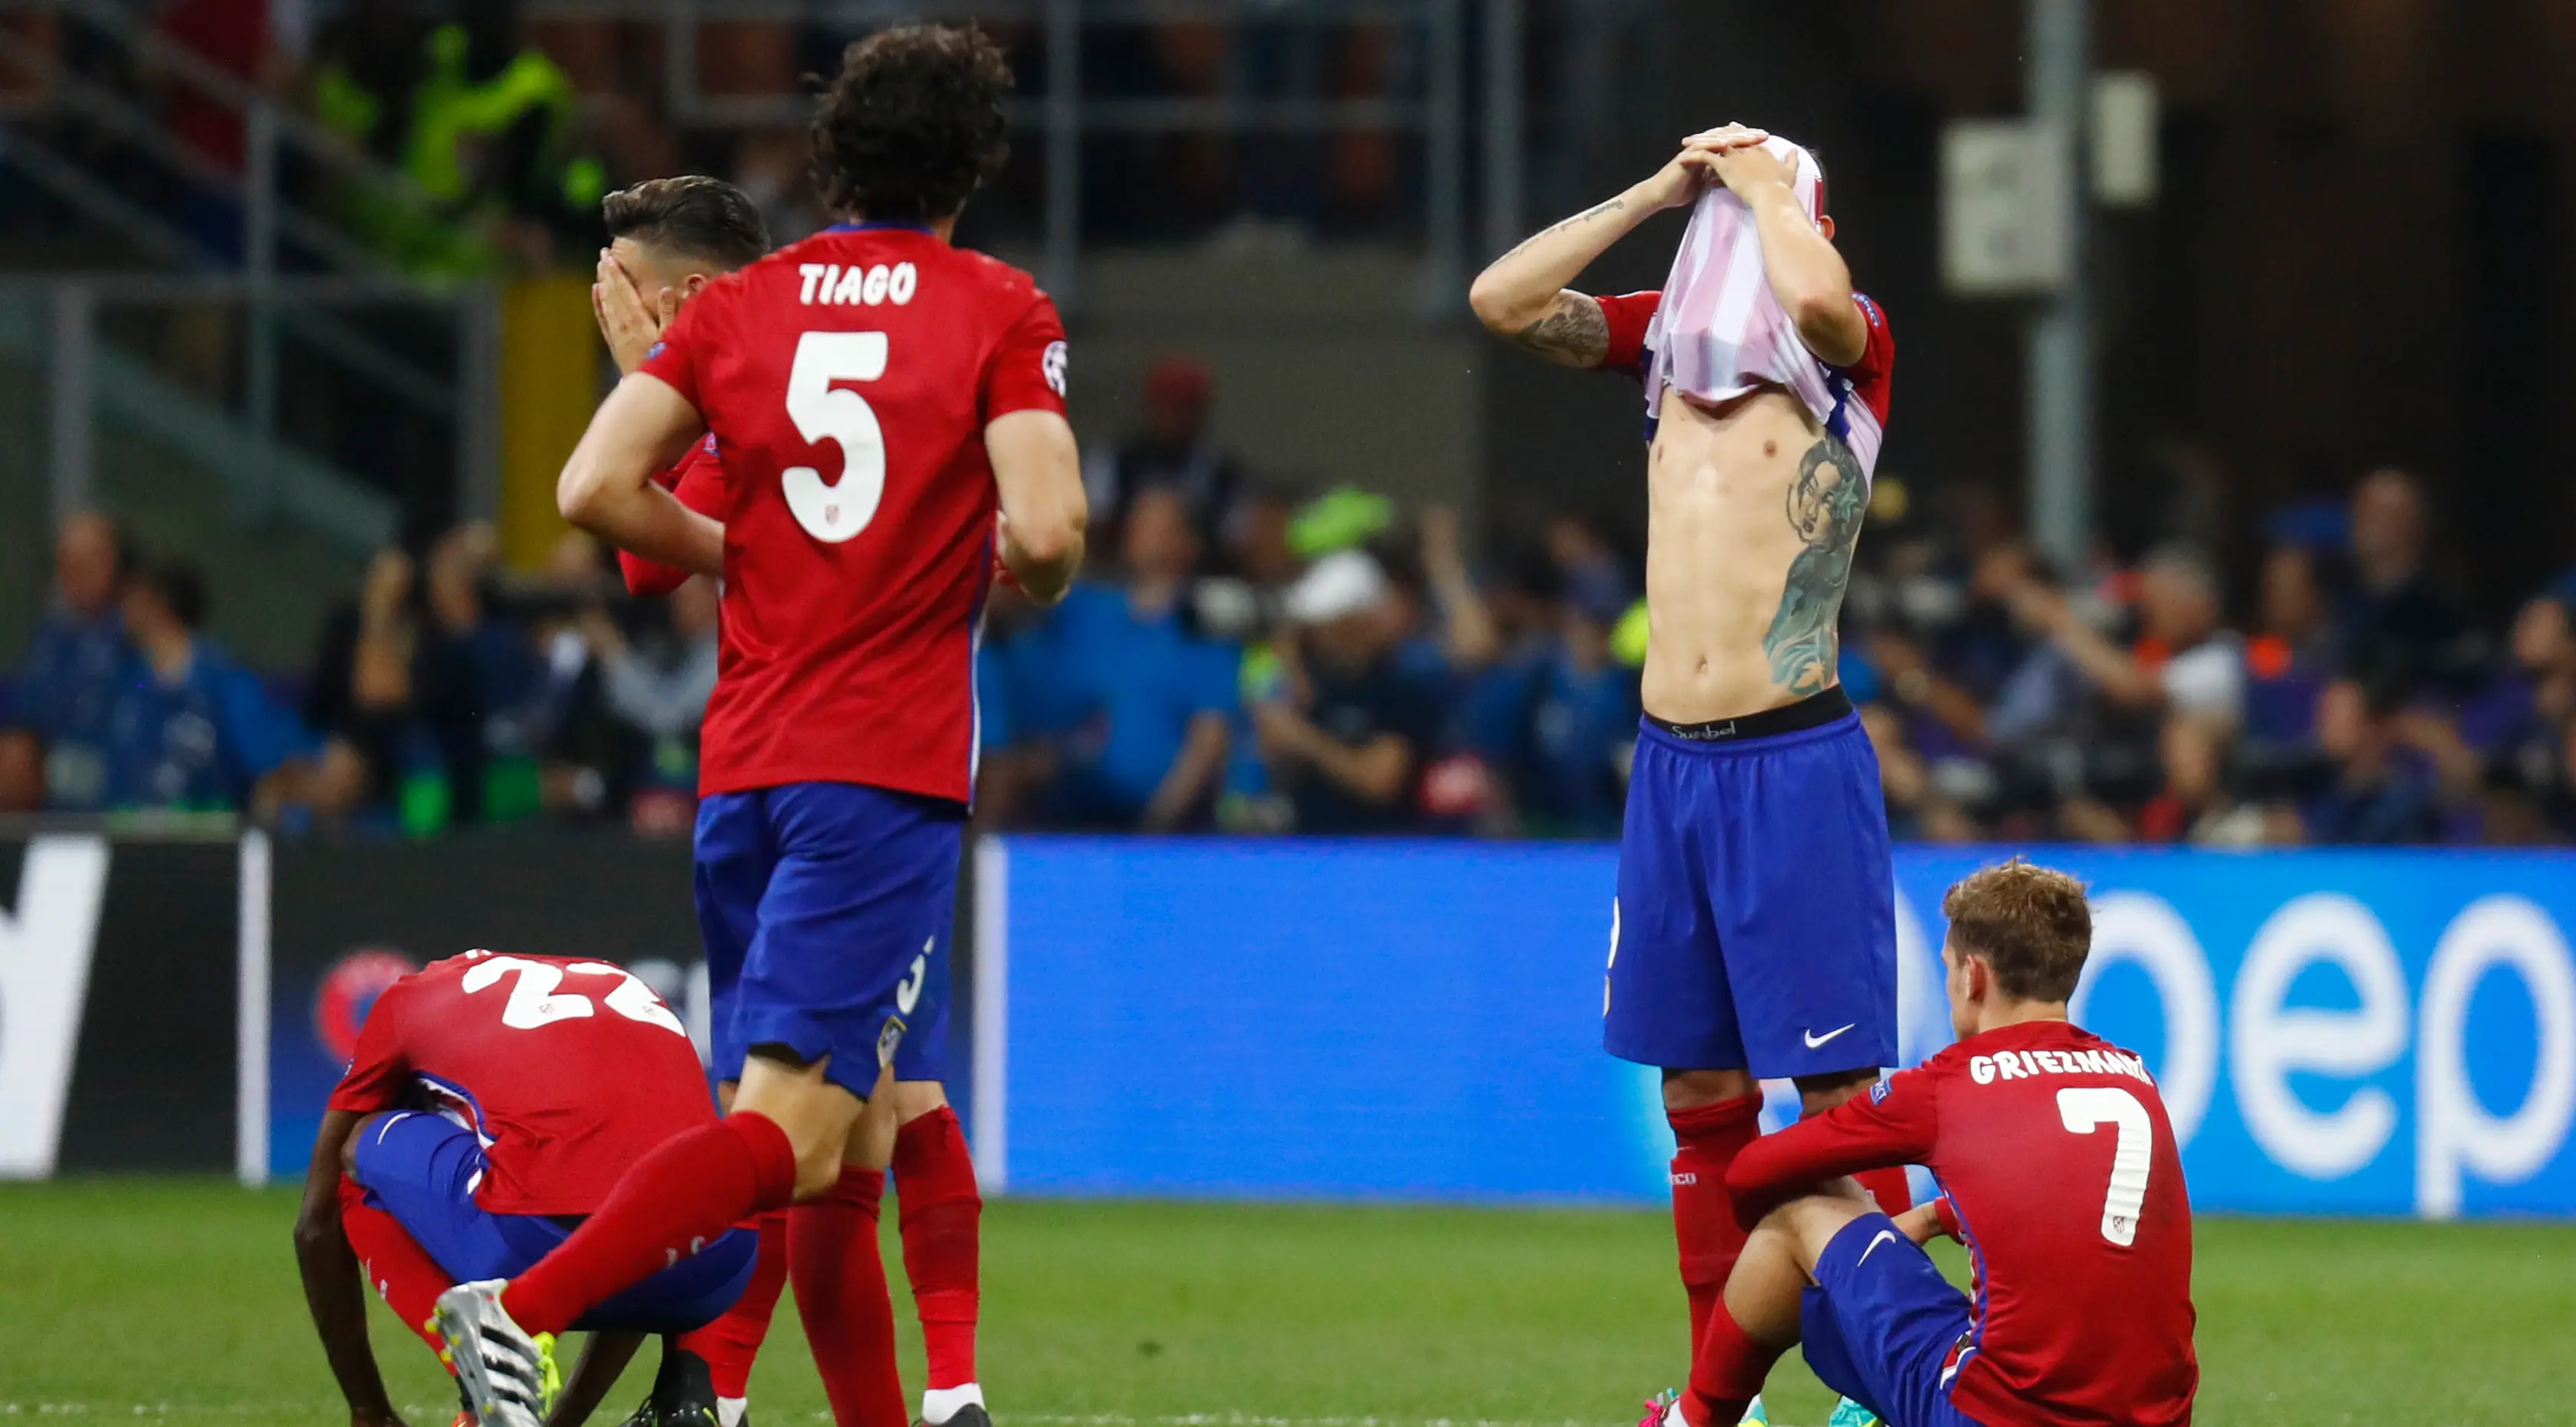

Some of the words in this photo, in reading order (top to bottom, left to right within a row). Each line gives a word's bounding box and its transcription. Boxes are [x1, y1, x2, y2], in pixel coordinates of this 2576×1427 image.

[799, 262, 917, 306] TIAGO
[781, 331, 889, 544] 5
[461, 955, 687, 1038] 22
[2056, 1087, 2153, 1247] 7
